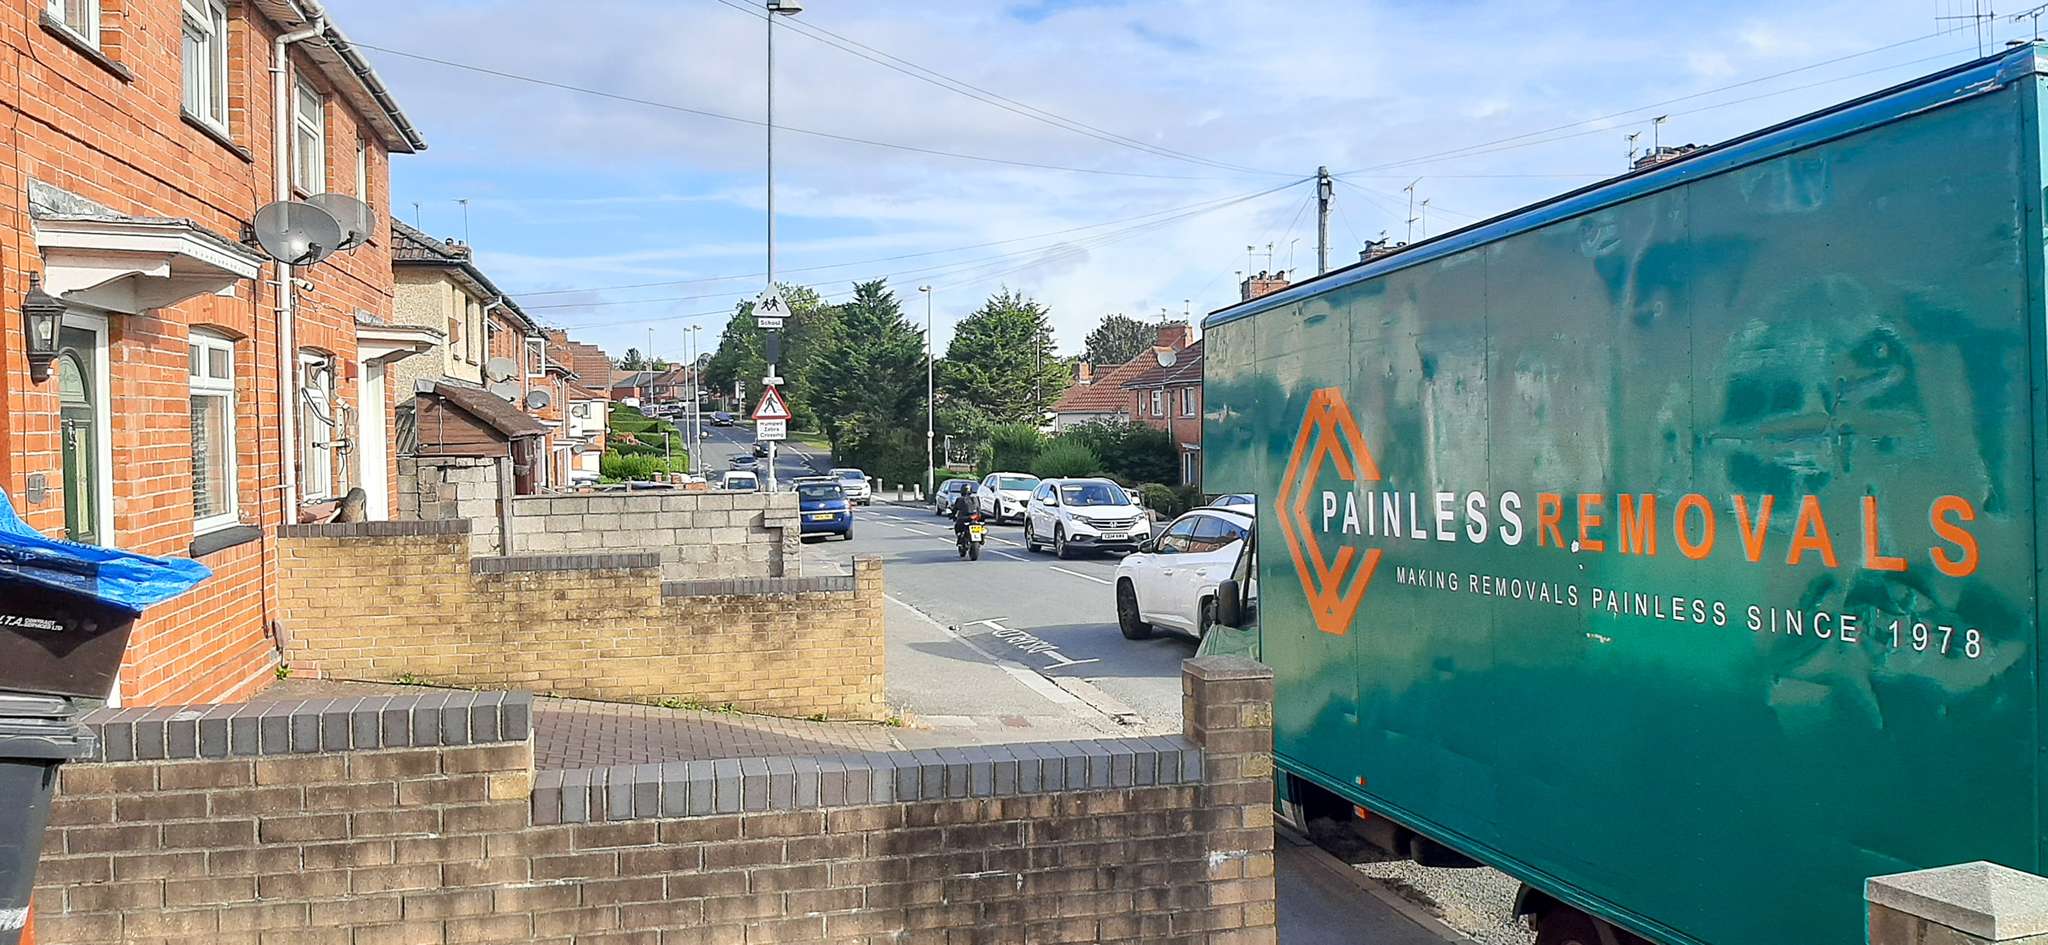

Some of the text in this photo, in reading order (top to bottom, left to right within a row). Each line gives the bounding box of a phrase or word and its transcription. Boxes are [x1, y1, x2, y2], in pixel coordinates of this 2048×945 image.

[1396, 566, 1982, 659] MAKING REMOVALS PAINLESS SINCE 1978
